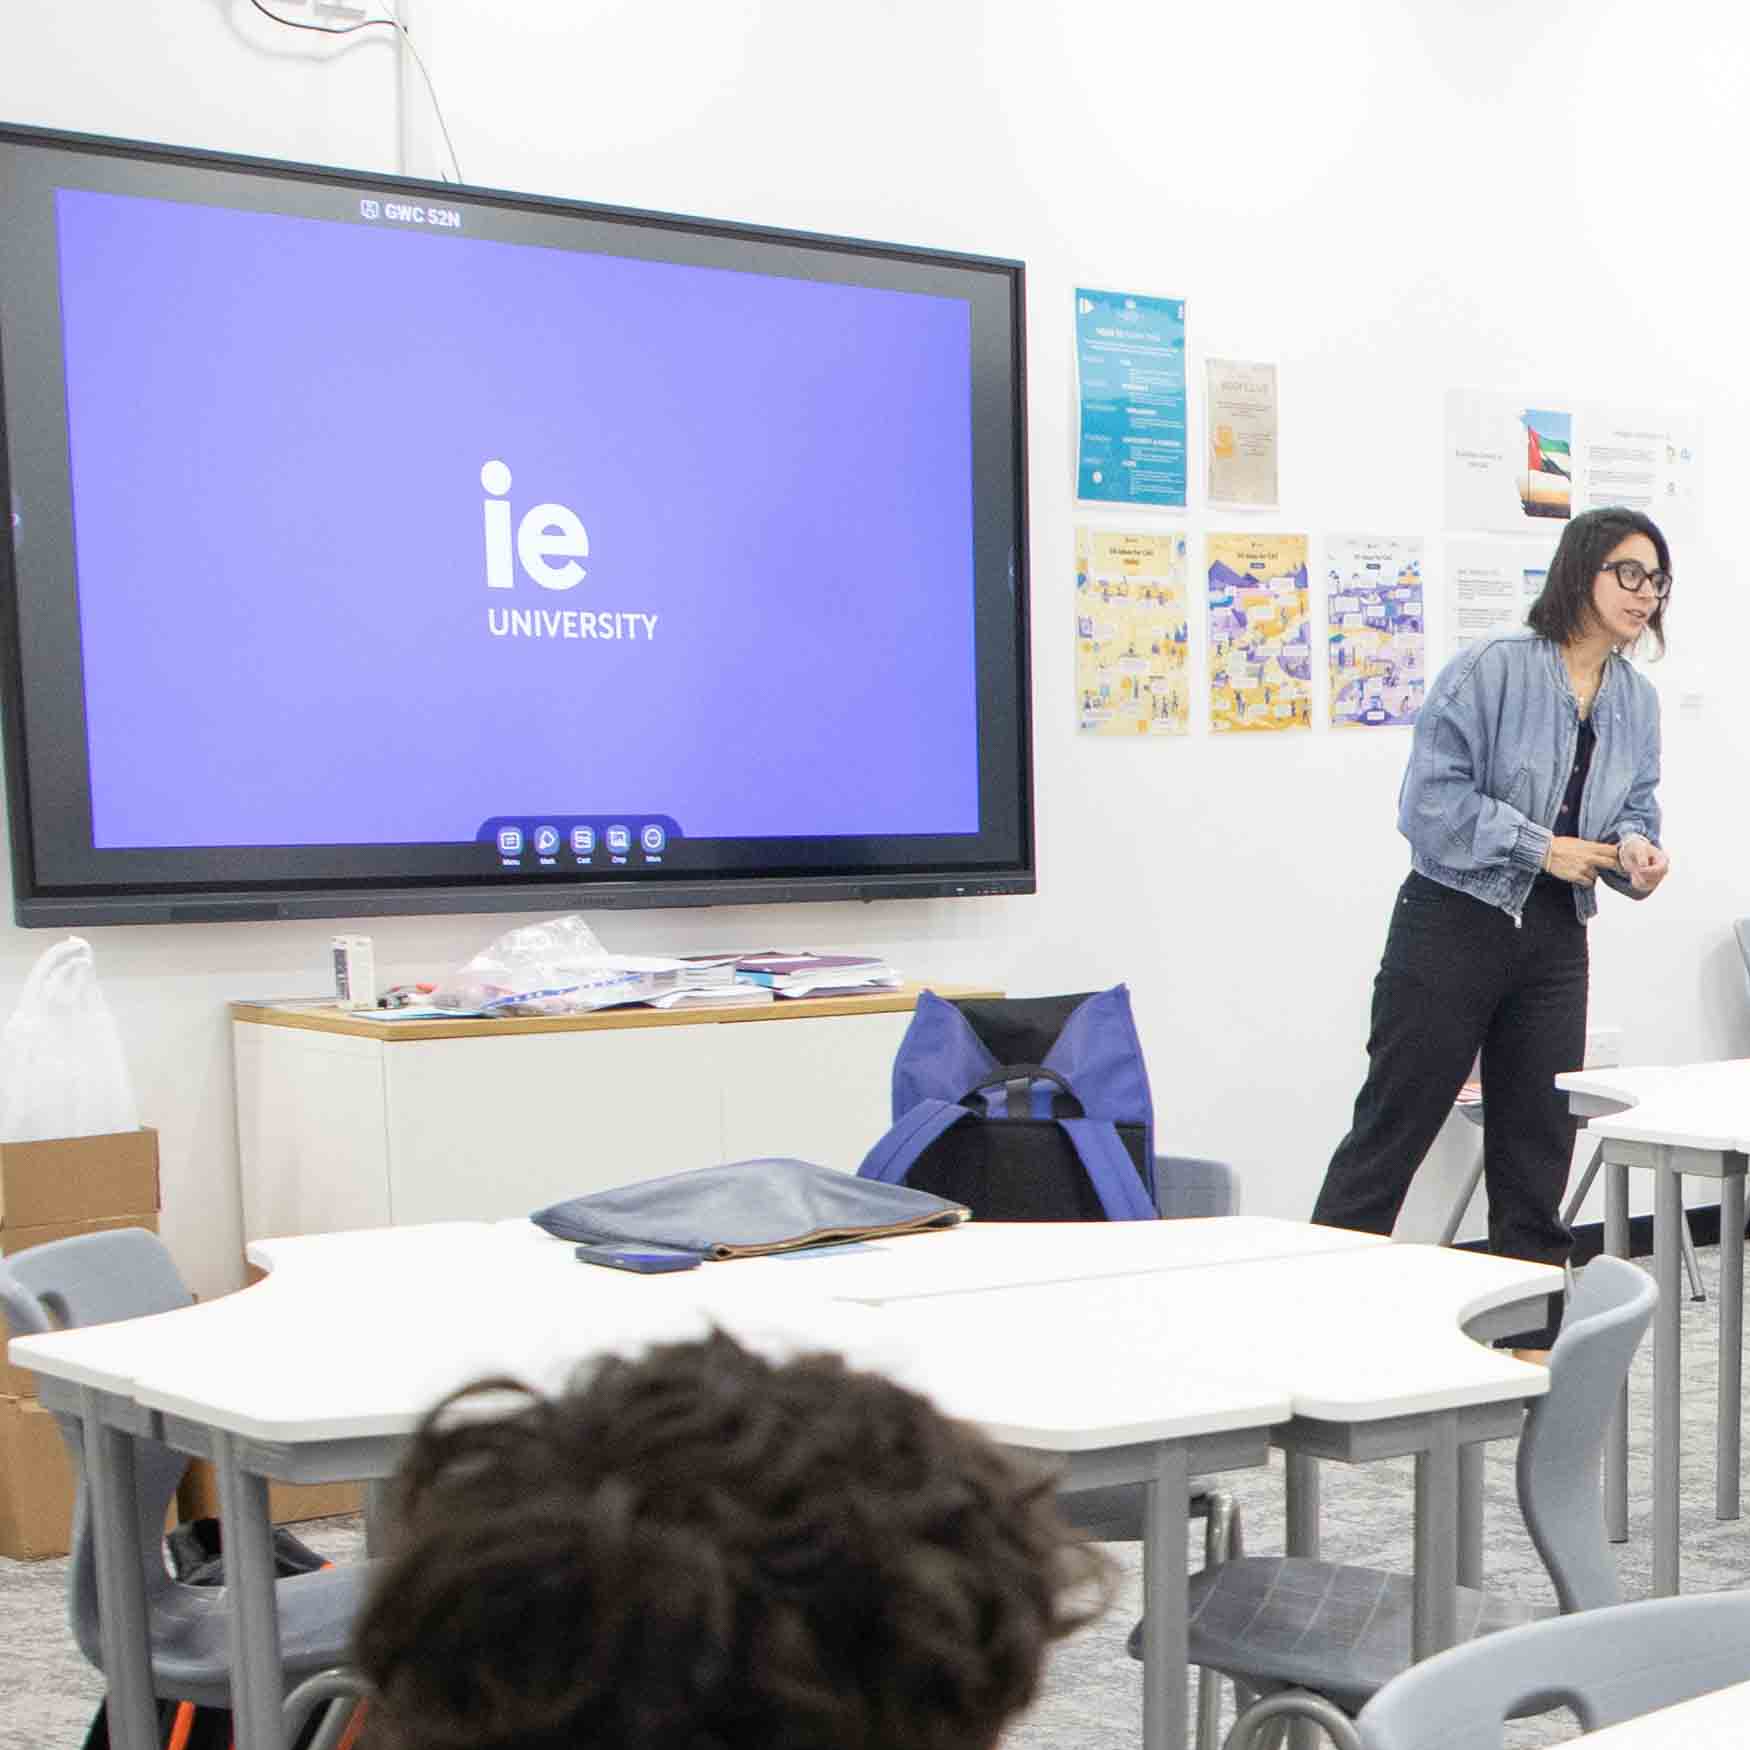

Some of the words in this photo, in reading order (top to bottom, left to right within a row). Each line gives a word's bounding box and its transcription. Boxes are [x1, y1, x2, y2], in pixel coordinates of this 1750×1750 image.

[385, 203, 425, 223] GWC
[479, 459, 590, 591] ie
[487, 607, 659, 641] UNIVERSITY
